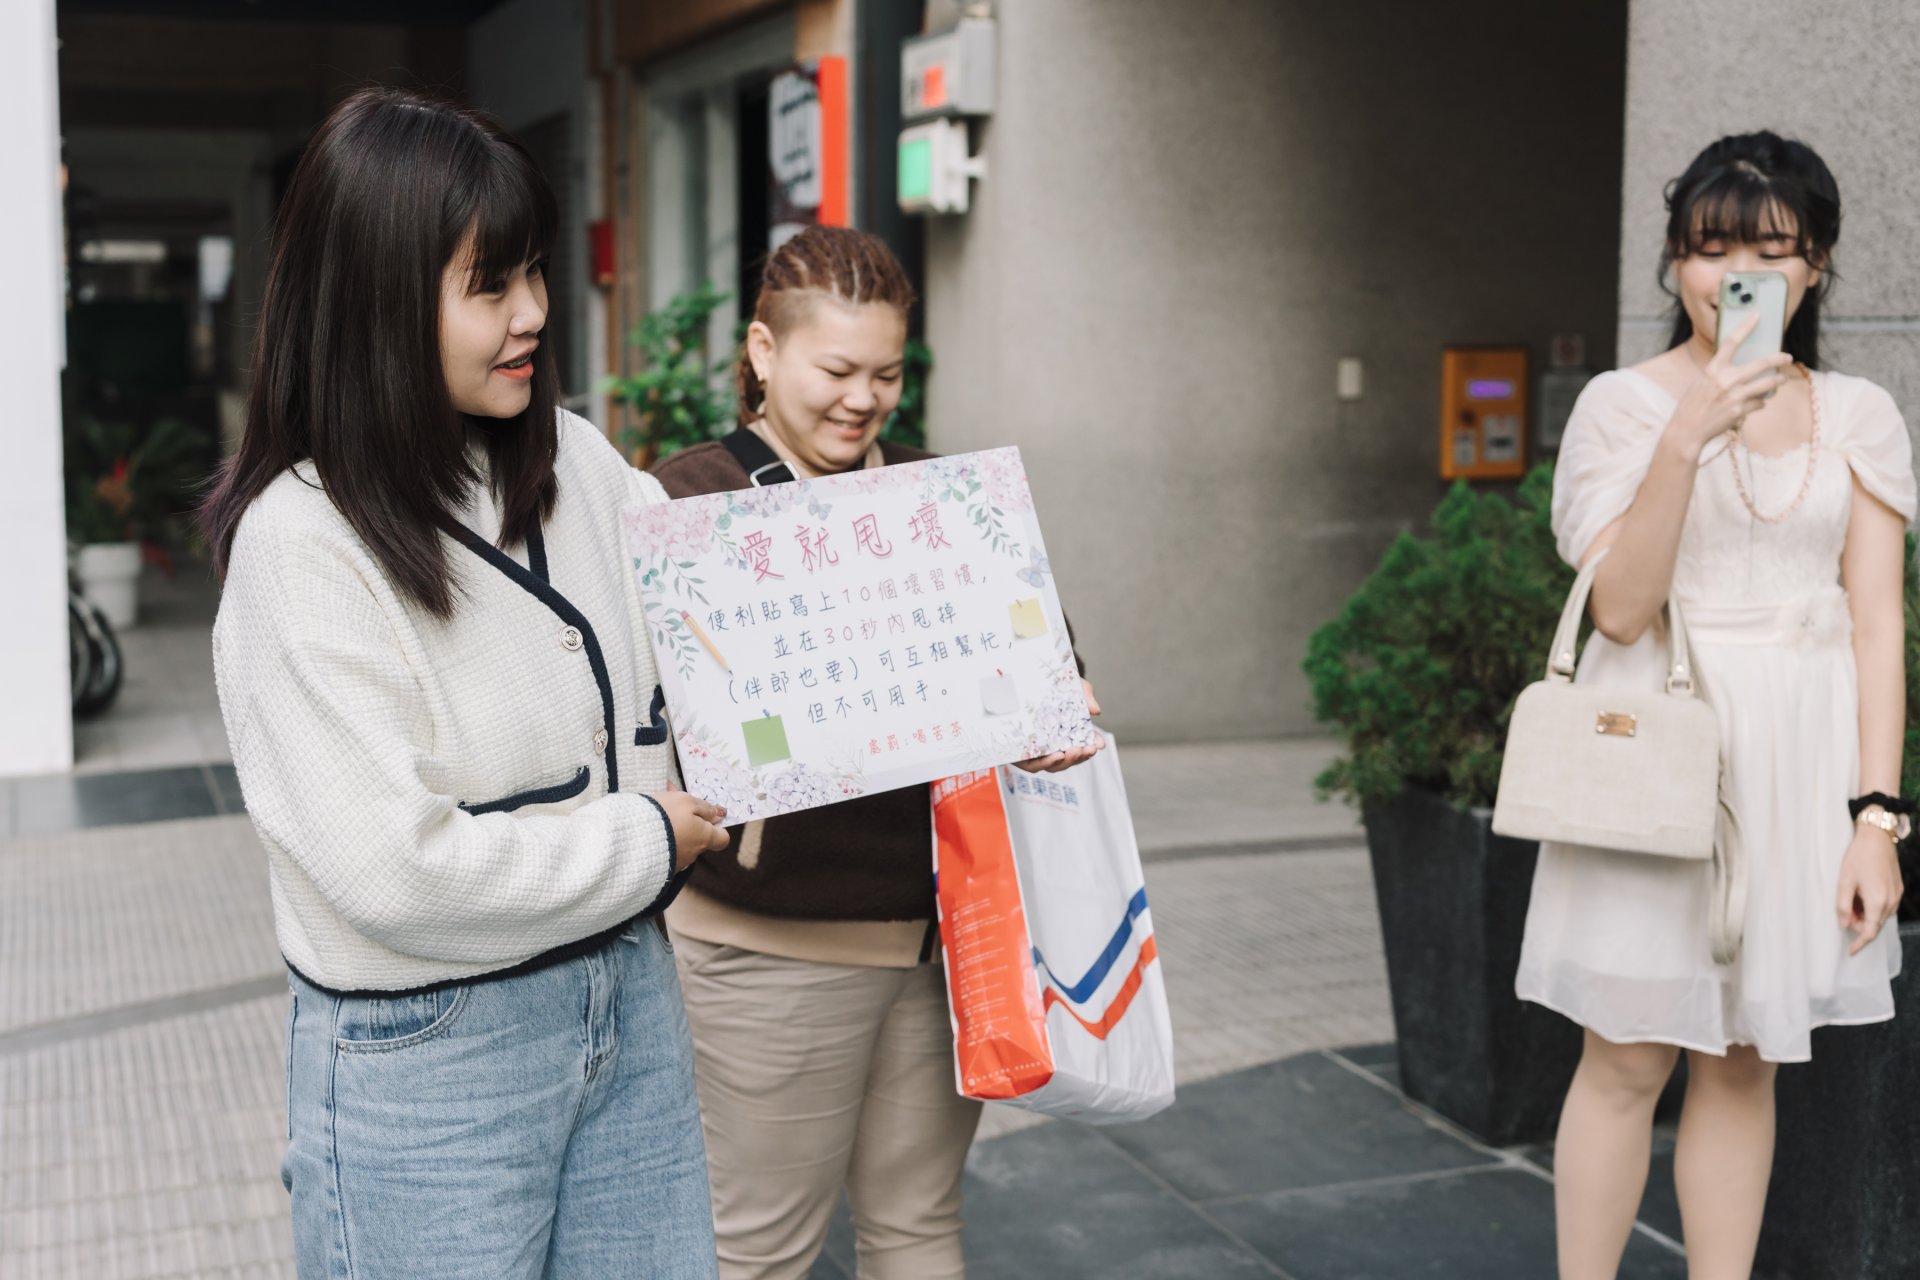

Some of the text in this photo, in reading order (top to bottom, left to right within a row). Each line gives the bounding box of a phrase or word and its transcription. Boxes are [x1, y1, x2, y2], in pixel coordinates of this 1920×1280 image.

[739, 501, 952, 583] 愛就甩壞
[773, 604, 957, 659] 並在30秒內甩掉
